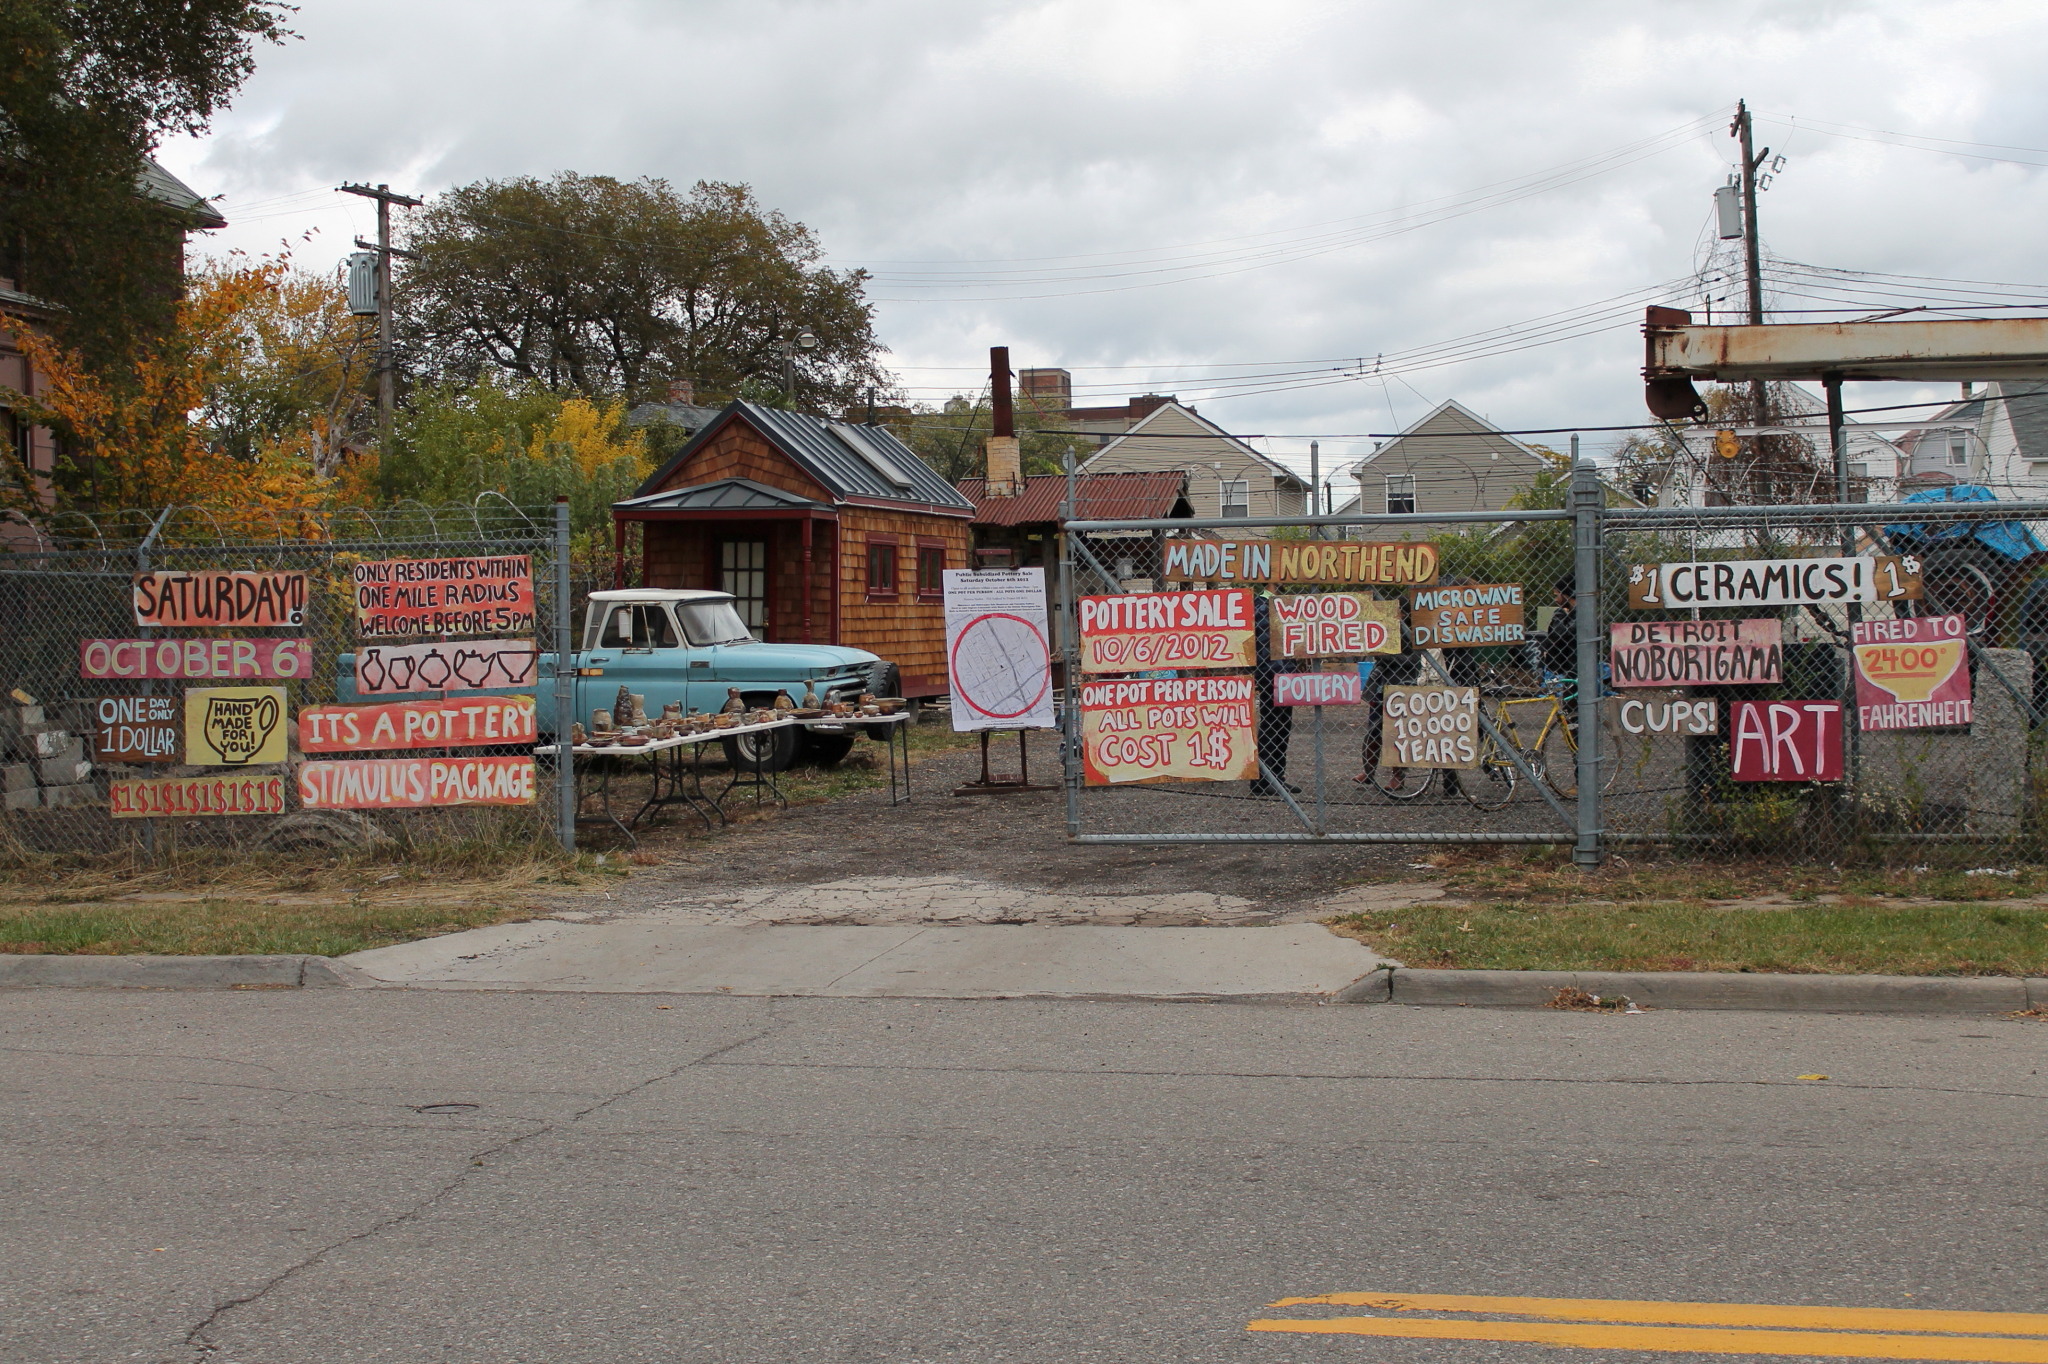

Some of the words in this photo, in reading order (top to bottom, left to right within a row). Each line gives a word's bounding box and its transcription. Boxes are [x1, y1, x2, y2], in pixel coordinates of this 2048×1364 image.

[355, 564, 391, 583] ONLY
[395, 560, 474, 581] RESIDENTS
[477, 558, 528, 579] WITHIN
[1165, 543, 1236, 578] MADE
[1243, 544, 1271, 578] IN
[1280, 545, 1435, 582] NORTHEND
[359, 586, 390, 609] ONE
[395, 586, 436, 608] MILE
[446, 582, 519, 604] RADIUS
[1670, 562, 1861, 602] CERAMICS!
[138, 575, 304, 624] SATURDAY!
[1081, 595, 1180, 632] POTTERY
[1181, 592, 1246, 627] SALE
[1274, 595, 1360, 623] WOOD
[1414, 587, 1521, 611] MICROWAVE
[360, 615, 429, 636] WELCOME
[434, 609, 492, 634] BEFORE
[1438, 608, 1500, 627] SAFE
[1853, 620, 1918, 643] FIRED
[1927, 616, 1961, 636] TO
[1283, 621, 1387, 657] FIRED
[1415, 624, 1524, 646] DISWASHER
[1630, 620, 1742, 643] DETROIT
[85, 641, 261, 677] OCTOBER
[272, 641, 311, 677] 6th
[1093, 633, 1234, 665] 10/6/2012
[1614, 644, 1782, 682] NOBORIGAMA
[1083, 684, 1114, 706] ONE
[1116, 682, 1151, 702] POT
[1154, 680, 1183, 703] PER
[1185, 679, 1252, 701] PERSON
[1277, 675, 1358, 704] POTTERY
[100, 698, 146, 724] ONE
[150, 698, 170, 708] DAY
[149, 709, 174, 720] ONLY
[214, 703, 253, 717] HAND
[1385, 689, 1458, 718] GOOD
[1621, 699, 1716, 734] CUPS!
[1859, 700, 1971, 730] FAHRENHEIT
[212, 717, 252, 730] MADE
[307, 712, 361, 744] ITS
[371, 713, 396, 743] A
[405, 703, 535, 742] POTTERY
[1099, 710, 1141, 732] ALL
[1148, 706, 1198, 729] POTS
[1201, 705, 1251, 727] WILL
[1394, 713, 1472, 739] 10,000
[101, 728, 115, 752] 1
[120, 726, 175, 756] DOLLAR
[220, 732, 255, 752] YOU!
[223, 729, 248, 740] FOR
[1734, 703, 1839, 775] ART
[1099, 733, 1177, 766] COST
[1187, 728, 1232, 770] 1$
[1394, 736, 1475, 763] YEARS
[301, 764, 424, 804] STIMULUS
[431, 763, 535, 799] PACKAGE
